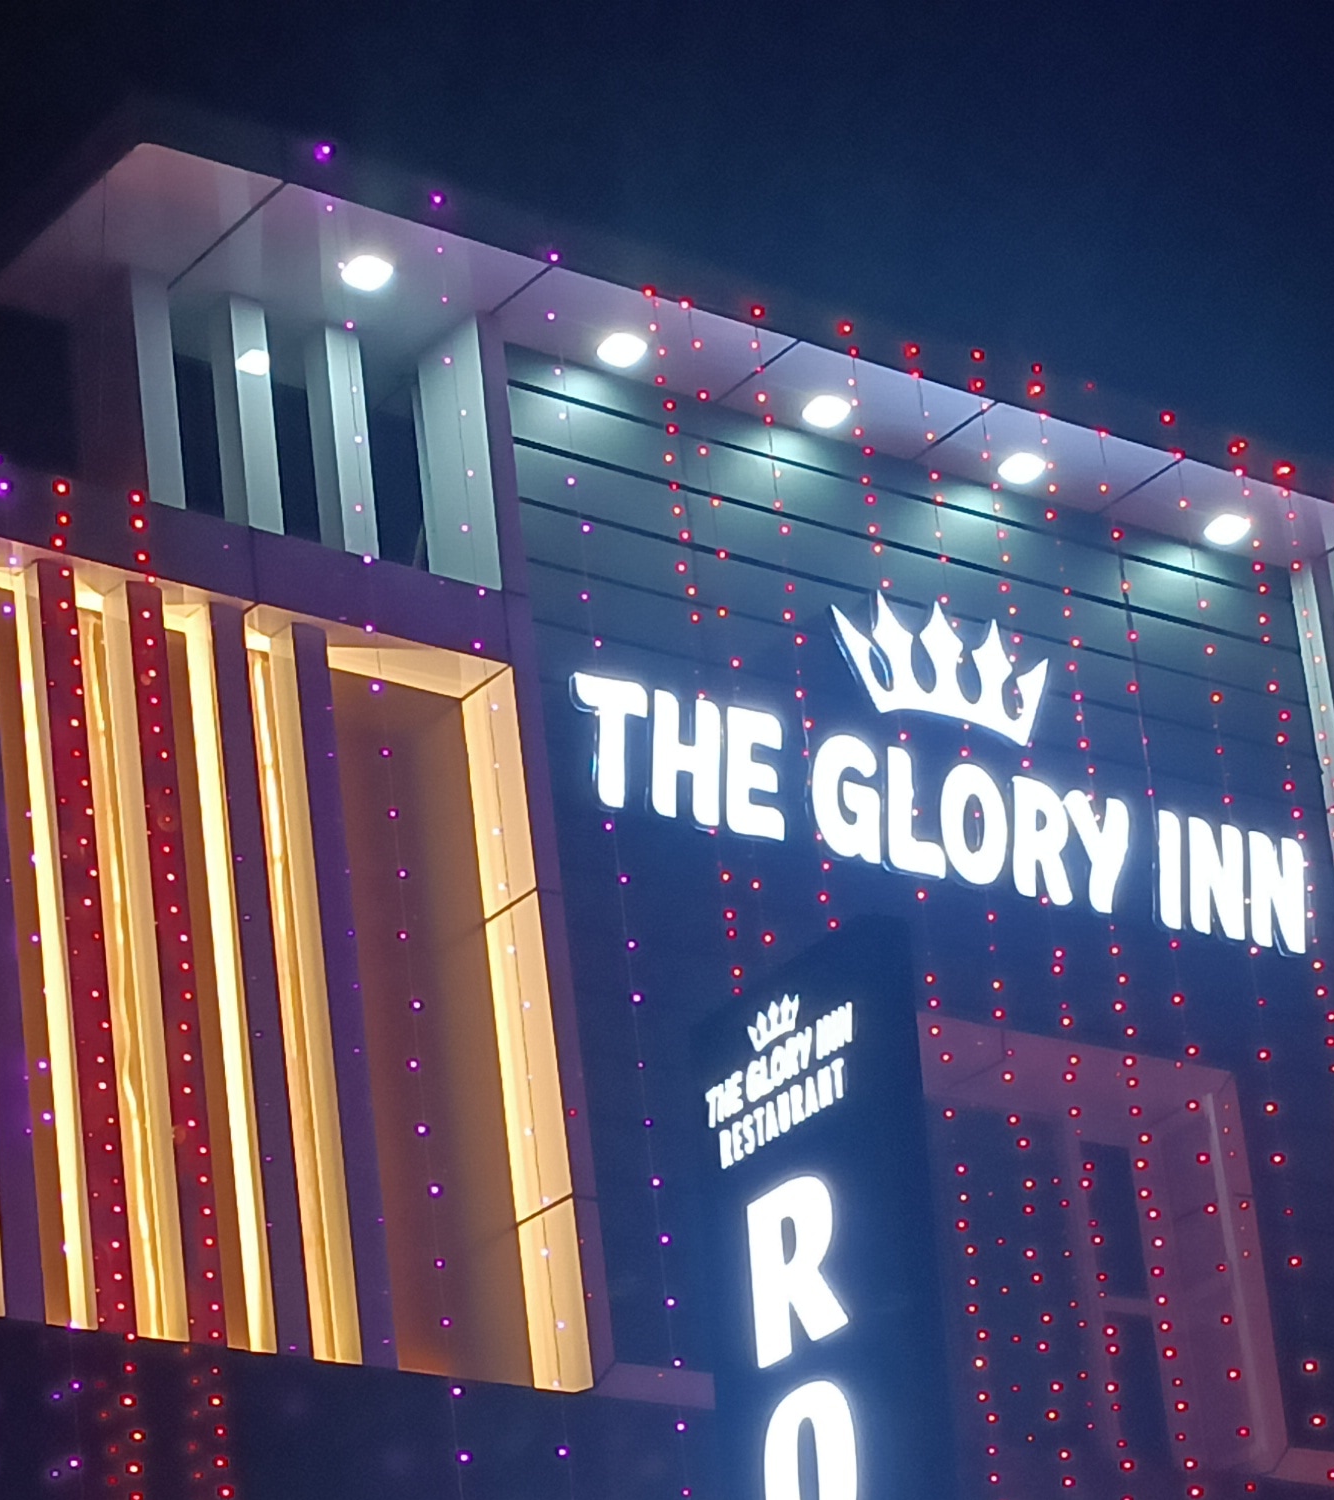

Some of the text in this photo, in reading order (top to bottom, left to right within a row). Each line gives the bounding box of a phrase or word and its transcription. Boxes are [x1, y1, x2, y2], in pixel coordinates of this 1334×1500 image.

[572, 672, 1308, 956] THE GLORY INN
[705, 1001, 853, 1129] THE GLORY INN
[719, 1057, 845, 1170] RESTAURANT
